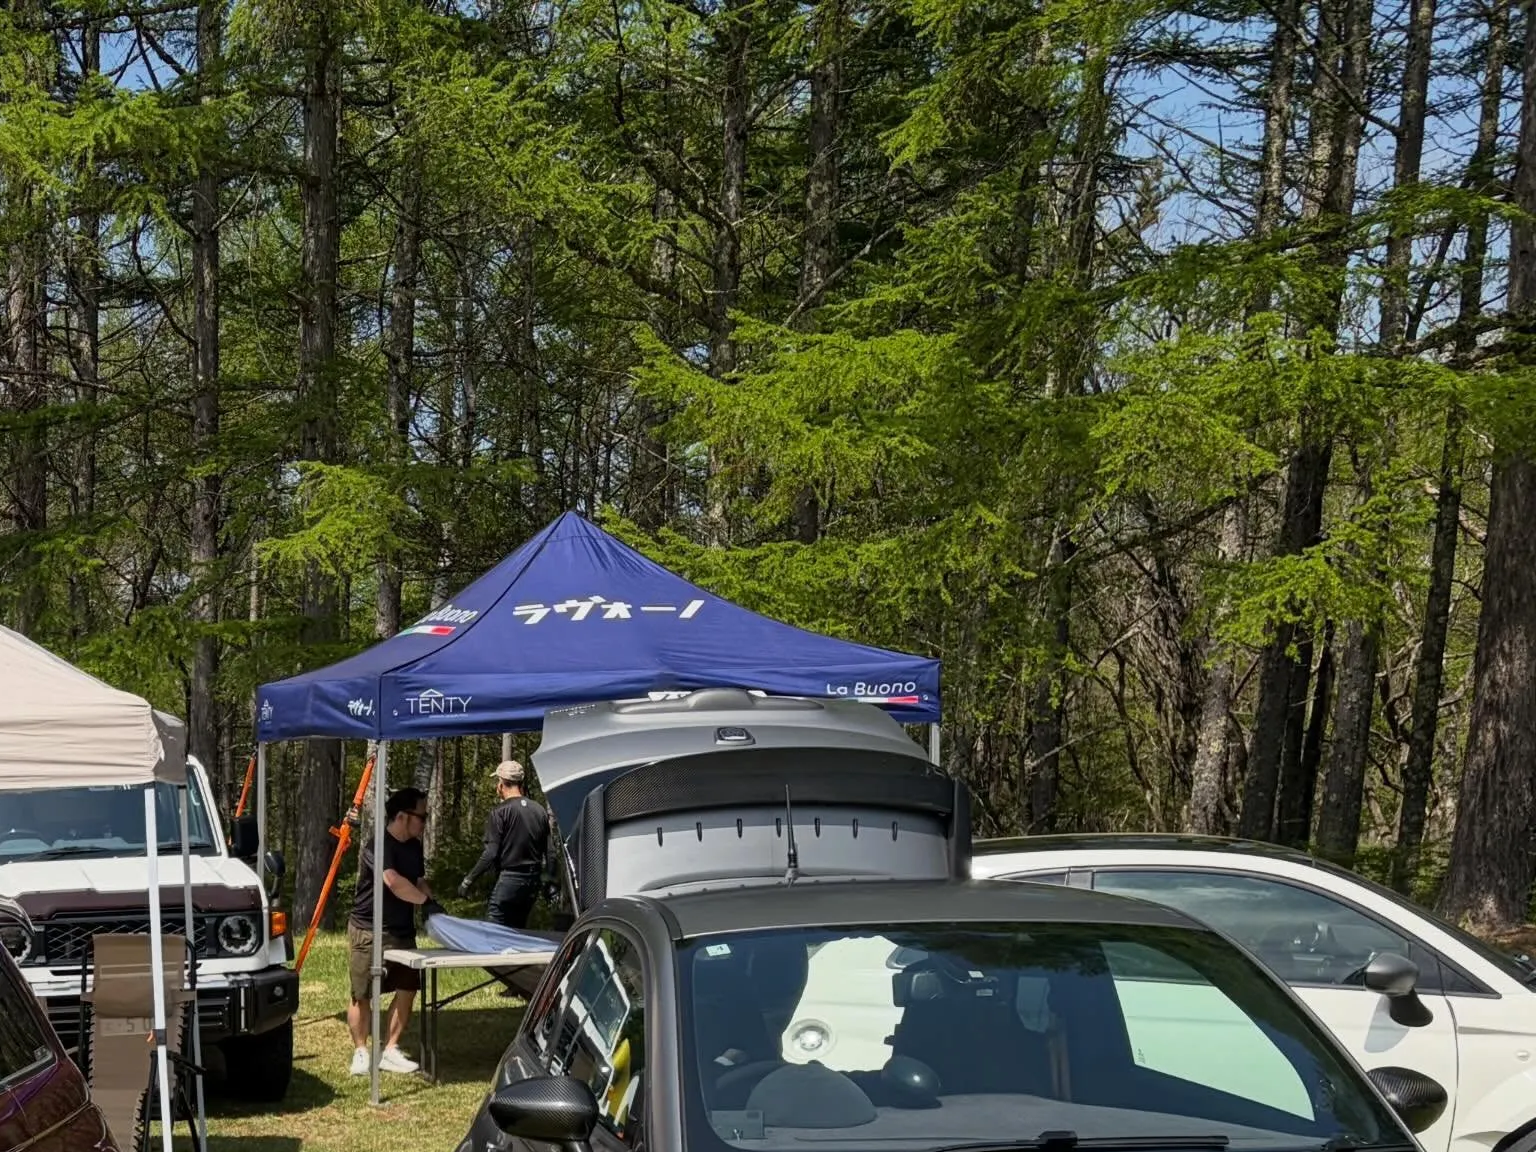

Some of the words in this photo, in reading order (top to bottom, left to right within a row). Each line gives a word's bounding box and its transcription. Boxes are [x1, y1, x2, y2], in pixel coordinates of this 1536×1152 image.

[826, 683, 848, 695] La
[854, 681, 917, 696] Buono
[406, 695, 472, 715] TENTY
